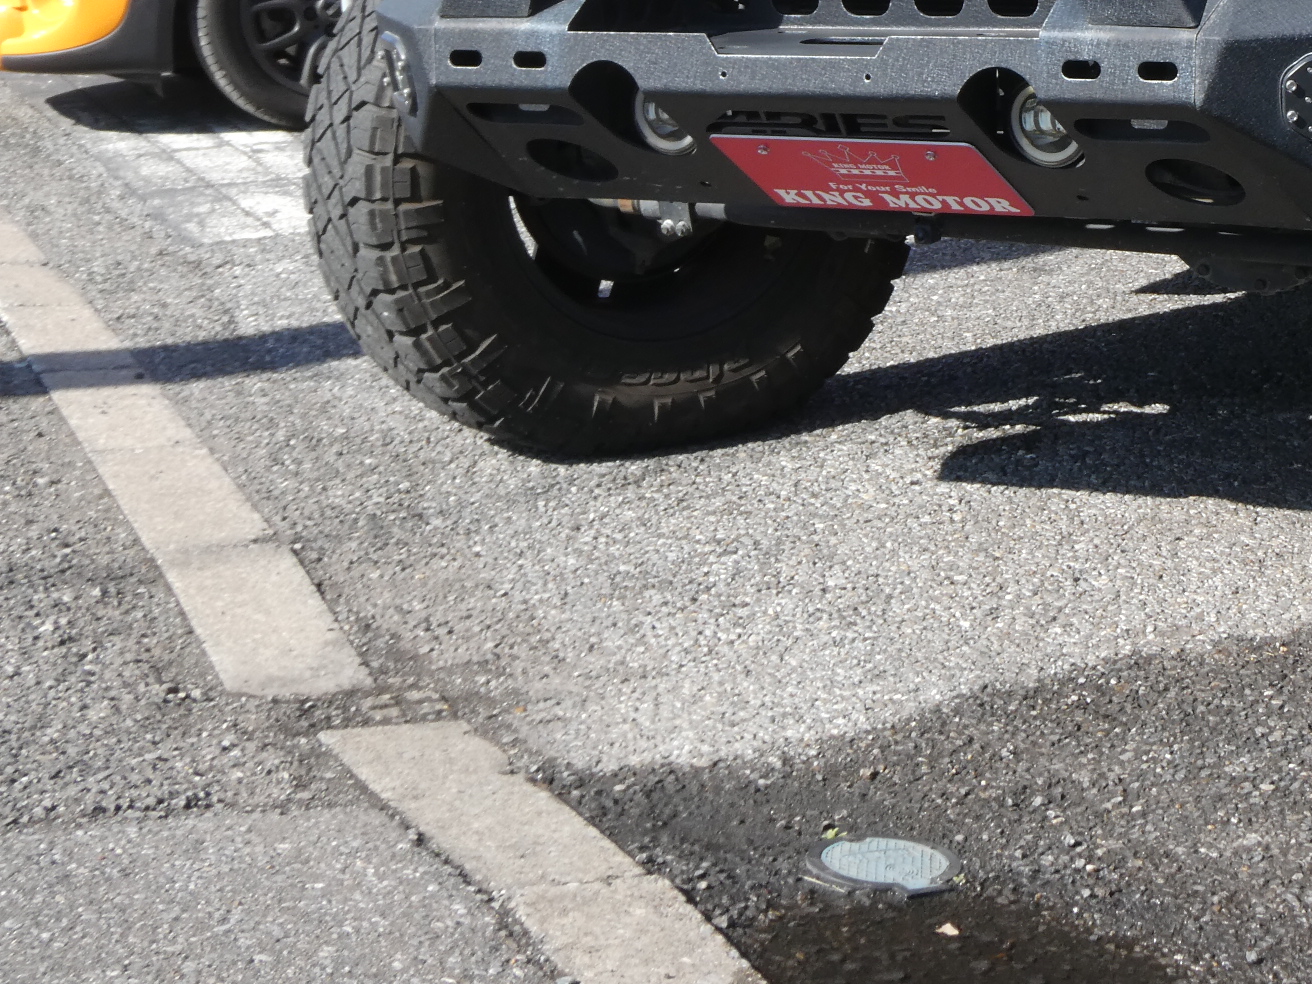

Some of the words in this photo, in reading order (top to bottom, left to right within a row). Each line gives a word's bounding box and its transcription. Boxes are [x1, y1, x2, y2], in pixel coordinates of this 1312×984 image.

[832, 162, 857, 170] KING
[858, 163, 892, 171] MOTOR
[829, 182, 854, 191] For
[856, 183, 892, 193] Your
[894, 184, 938, 194] Smile
[774, 189, 874, 207] KING
[879, 193, 1021, 213] MOTOR
